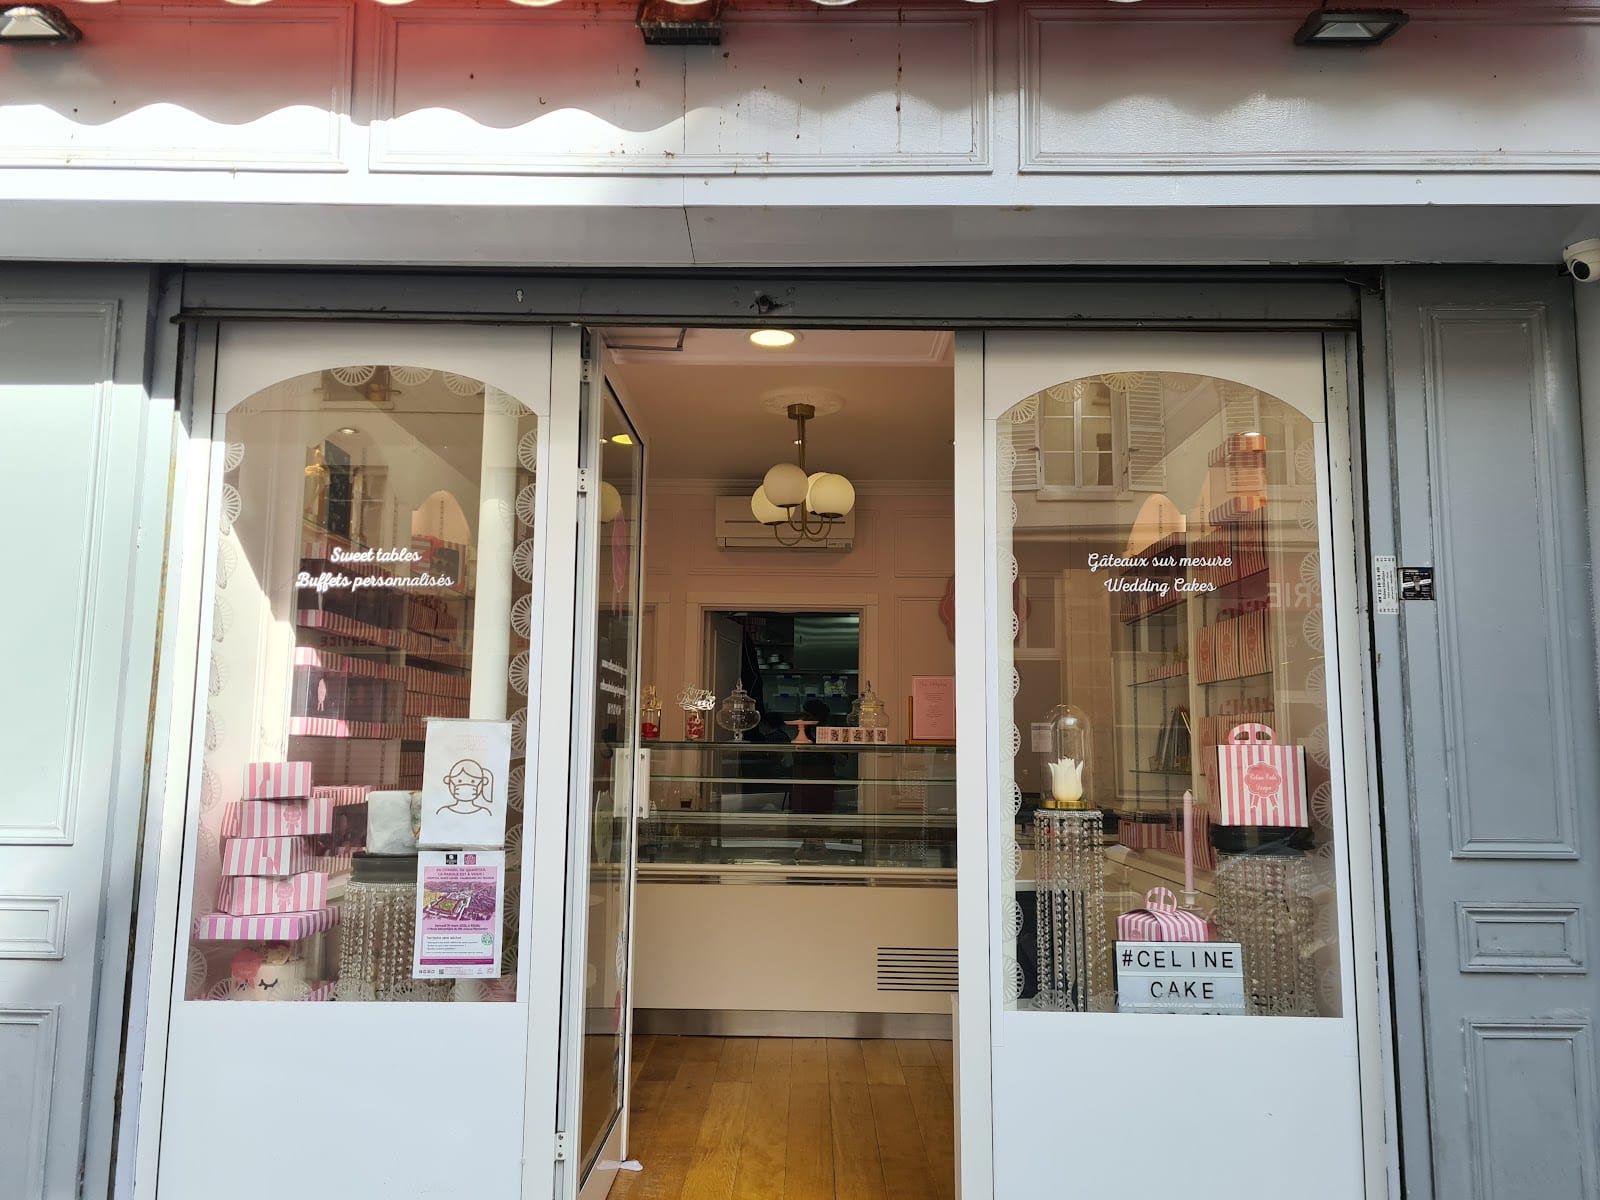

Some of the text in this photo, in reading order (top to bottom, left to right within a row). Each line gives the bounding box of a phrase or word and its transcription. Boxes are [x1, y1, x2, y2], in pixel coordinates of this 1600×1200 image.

[330, 546, 422, 563] Sweet tables
[1088, 552, 1233, 573] Gâteaux sur mesure
[295, 571, 455, 592] Buffets personnalisés
[1104, 577, 1217, 597] Wedding Cakes
[1121, 949, 1234, 969] #CELINE
[1150, 981, 1214, 1000] CAKE
